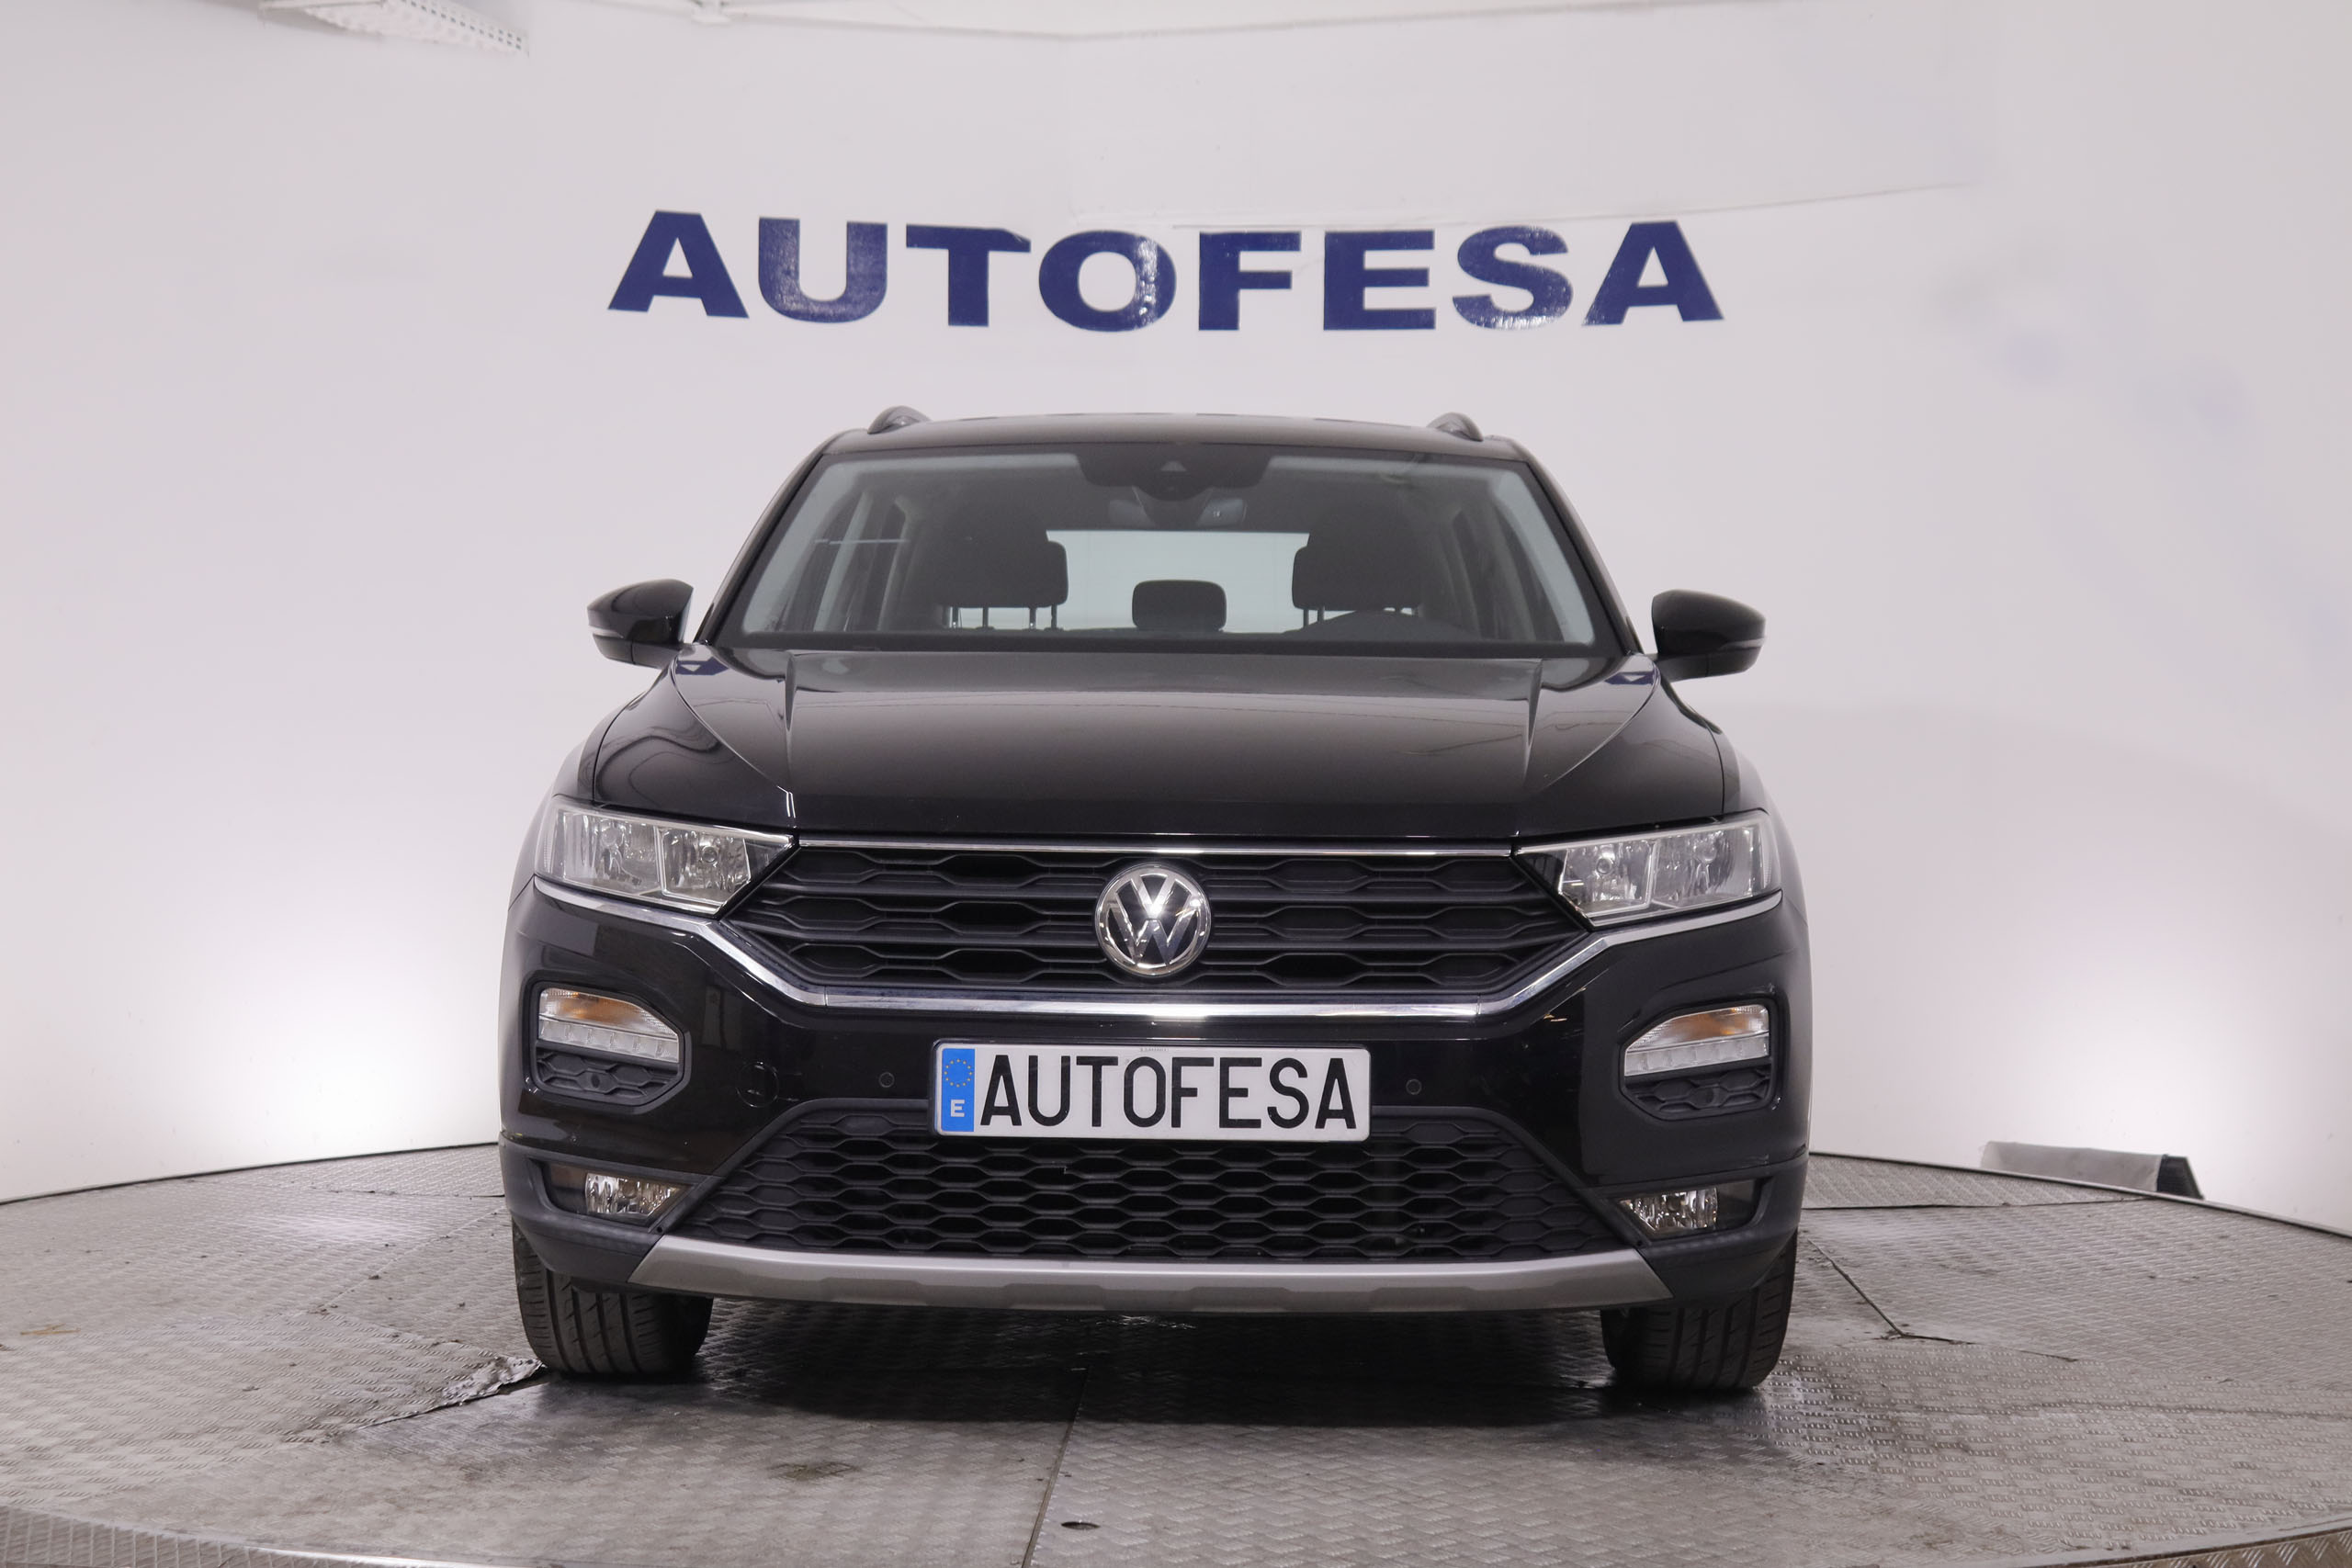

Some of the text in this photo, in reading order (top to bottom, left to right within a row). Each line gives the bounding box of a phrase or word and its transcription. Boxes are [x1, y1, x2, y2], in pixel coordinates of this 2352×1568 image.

[607, 210, 1724, 333] AUTOFESA
[1098, 866, 1208, 974] VW
[950, 1055, 1357, 1130] E AUTOFESA
